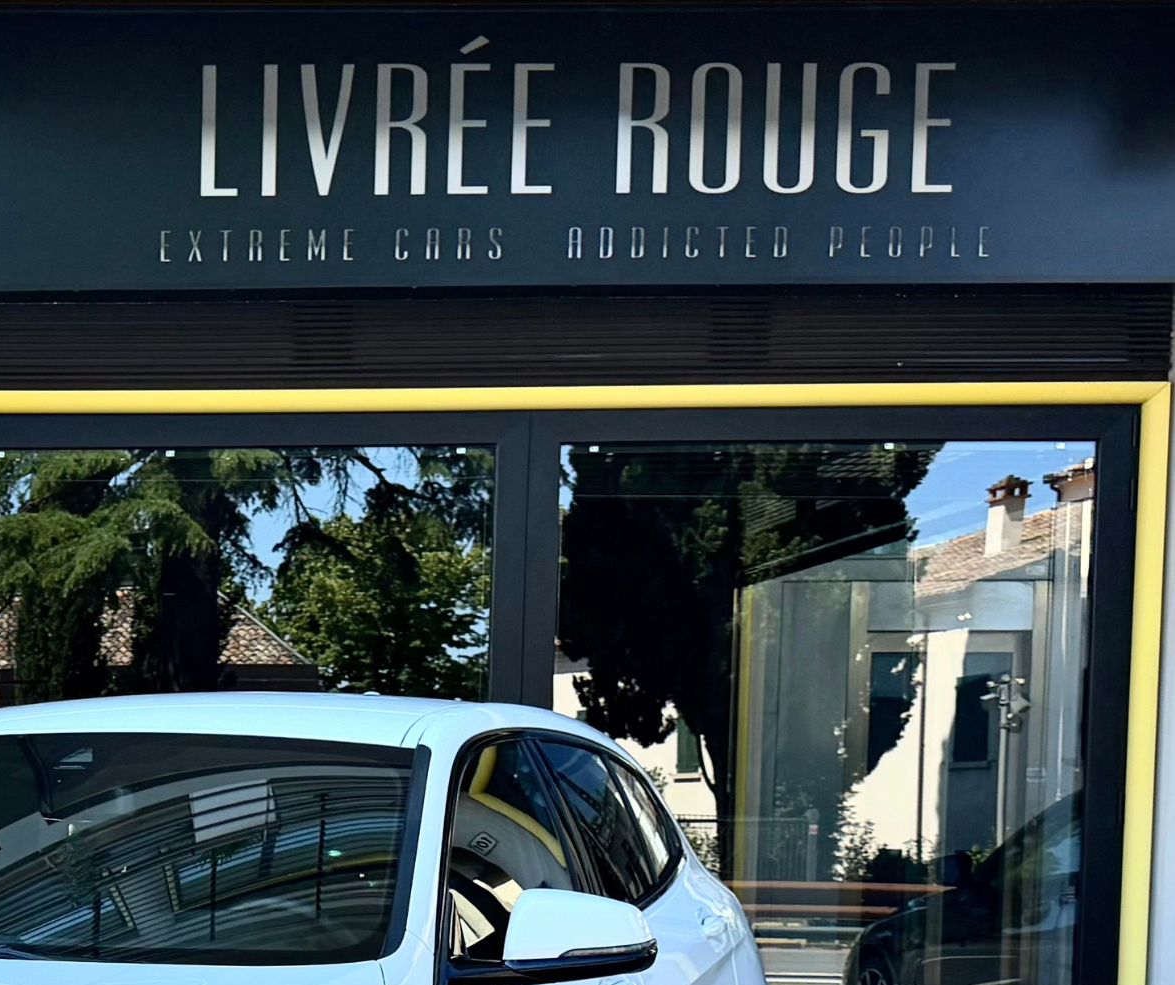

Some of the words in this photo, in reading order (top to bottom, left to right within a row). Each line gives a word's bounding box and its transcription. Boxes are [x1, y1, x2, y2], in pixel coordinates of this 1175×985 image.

[200, 35, 556, 196] LIVRÉE
[615, 61, 956, 194] ROUGE
[159, 228, 354, 262] EXTREME
[394, 227, 503, 260] CARS
[567, 226, 788, 259] ADDICTED
[828, 226, 990, 258] PEOPLE
